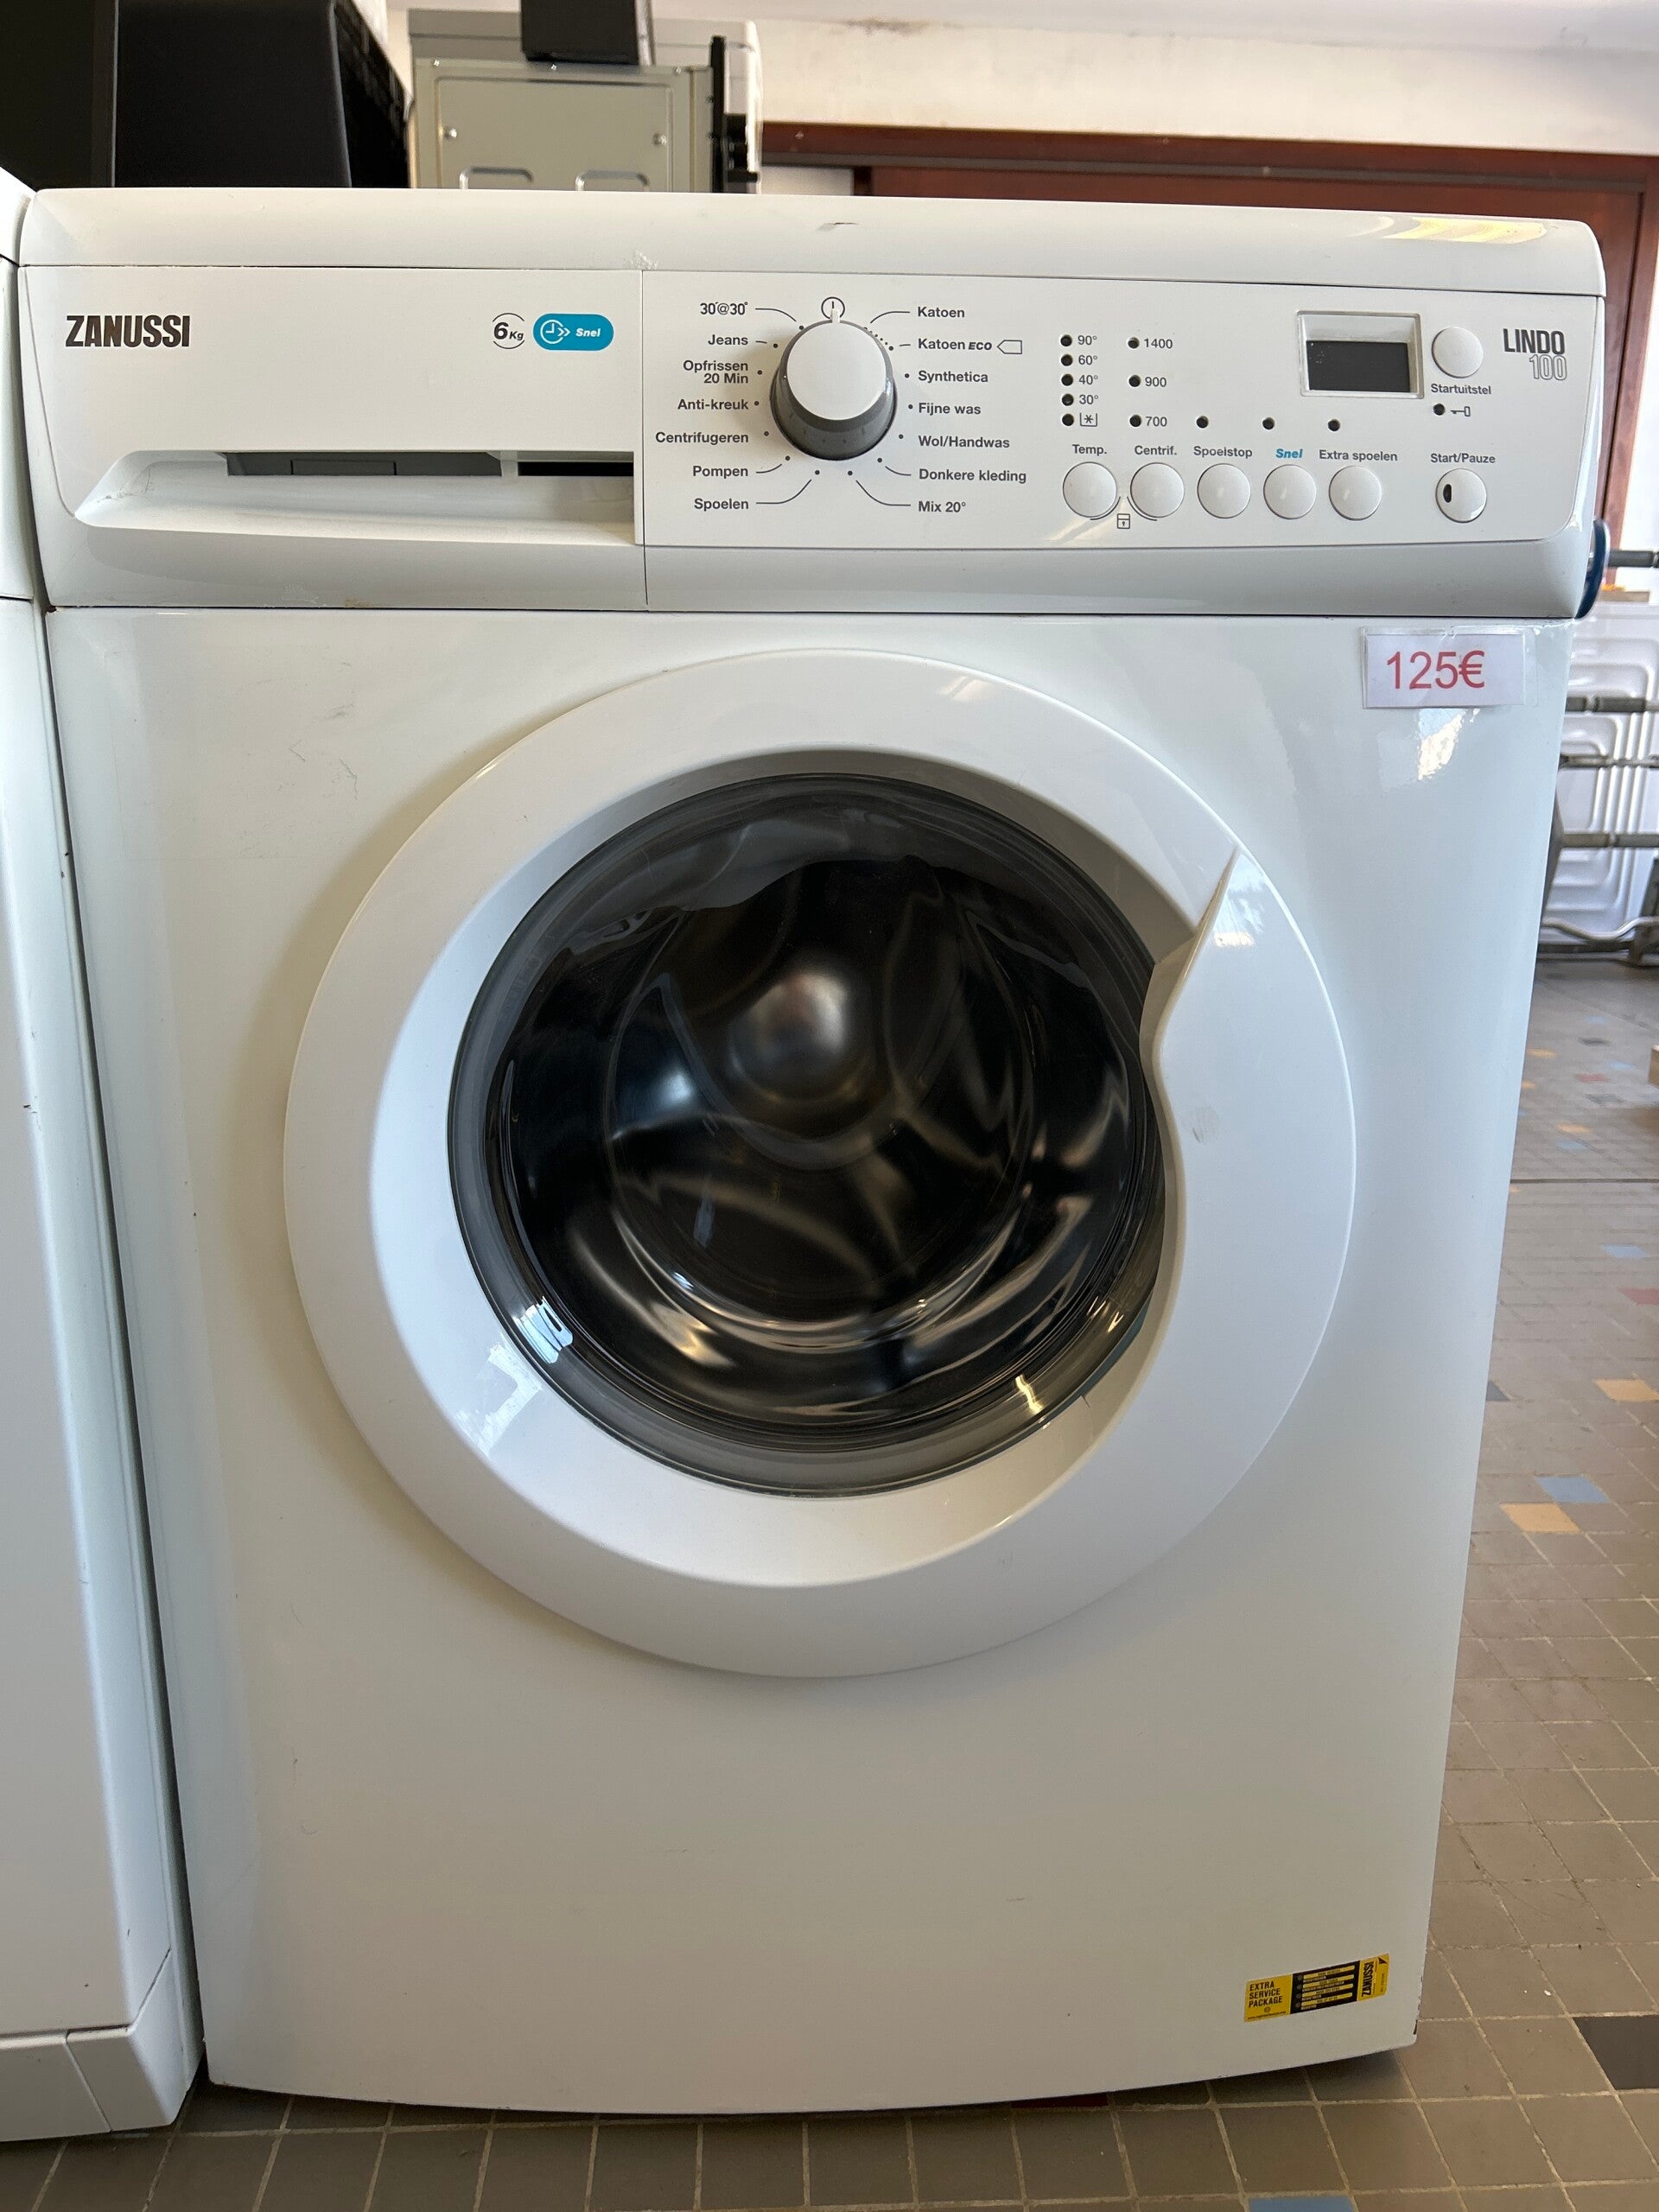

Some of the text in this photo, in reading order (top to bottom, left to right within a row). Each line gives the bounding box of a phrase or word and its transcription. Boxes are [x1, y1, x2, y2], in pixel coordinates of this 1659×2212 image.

[918, 307, 964, 317] Katoen
[66, 315, 190, 347] ZANUSSI
[575, 328, 601, 337] Snel
[708, 334, 748, 345] Jeans
[918, 339, 965, 349] Katoen
[1144, 339, 1173, 349] 1400
[1503, 328, 1565, 354] LINDO
[683, 360, 748, 373] Opfrissen
[1529, 354, 1567, 380] 100
[704, 373, 748, 384] 20 Min
[918, 371, 988, 383] Synthetica
[1145, 377, 1166, 387] 900
[1431, 384, 1491, 394] Startuitstel
[677, 399, 749, 410] Anti-kreuk
[919, 403, 950, 416] Fijne
[1146, 416, 1167, 427] 700
[656, 432, 748, 445] Centrifugeren
[918, 435, 1009, 448] Wol/Handwas
[1072, 444, 1397, 462] Temp. Centrif. Spoelstop Snel Extra spoelen
[1431, 453, 1495, 463] Start/Pauze
[693, 466, 748, 479] Pompen
[919, 468, 1026, 484] Donkere kleding
[695, 499, 748, 512] Spoelen
[918, 501, 941, 512] Mix
[1387, 651, 1484, 690] 125€
[1362, 1961, 1375, 1997] ZANUSSI
[1249, 1980, 1274, 1992] EXTRA
[1249, 1988, 1281, 1999] SERVICE
[1249, 1996, 1282, 2008] PACKAGE
